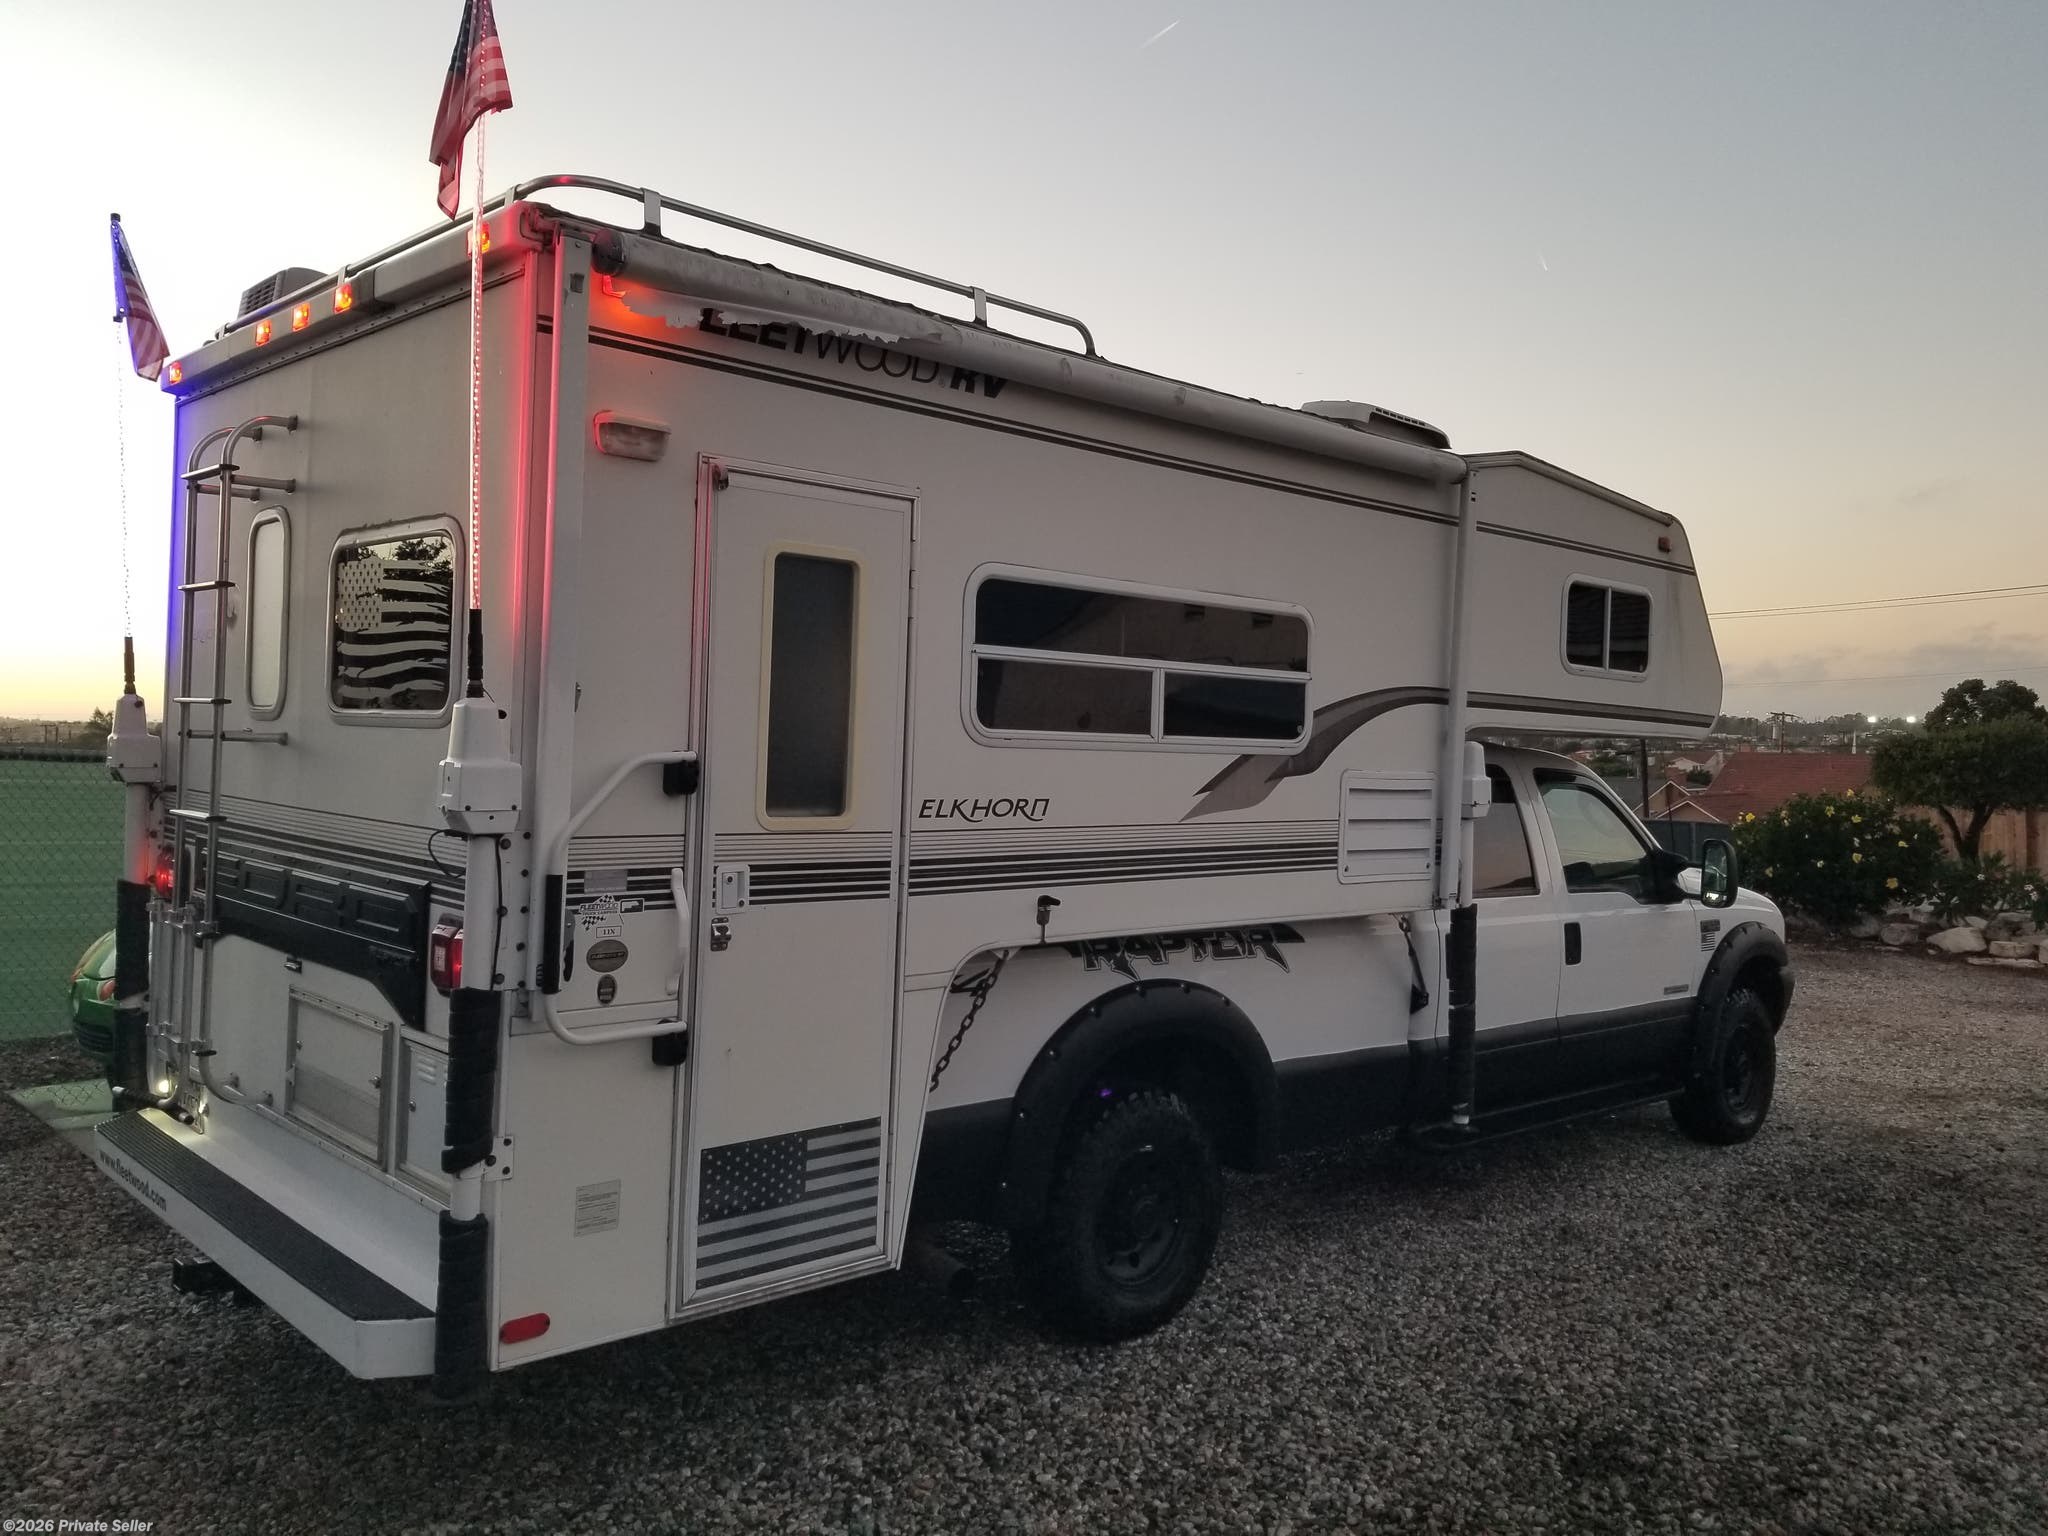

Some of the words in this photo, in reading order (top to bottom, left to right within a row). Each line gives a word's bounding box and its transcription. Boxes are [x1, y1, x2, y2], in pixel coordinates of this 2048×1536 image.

[699, 307, 939, 383] LEETWOOD
[919, 798, 1050, 823] ELKHORN
[99, 1149, 168, 1213] www.fleetwood.com
